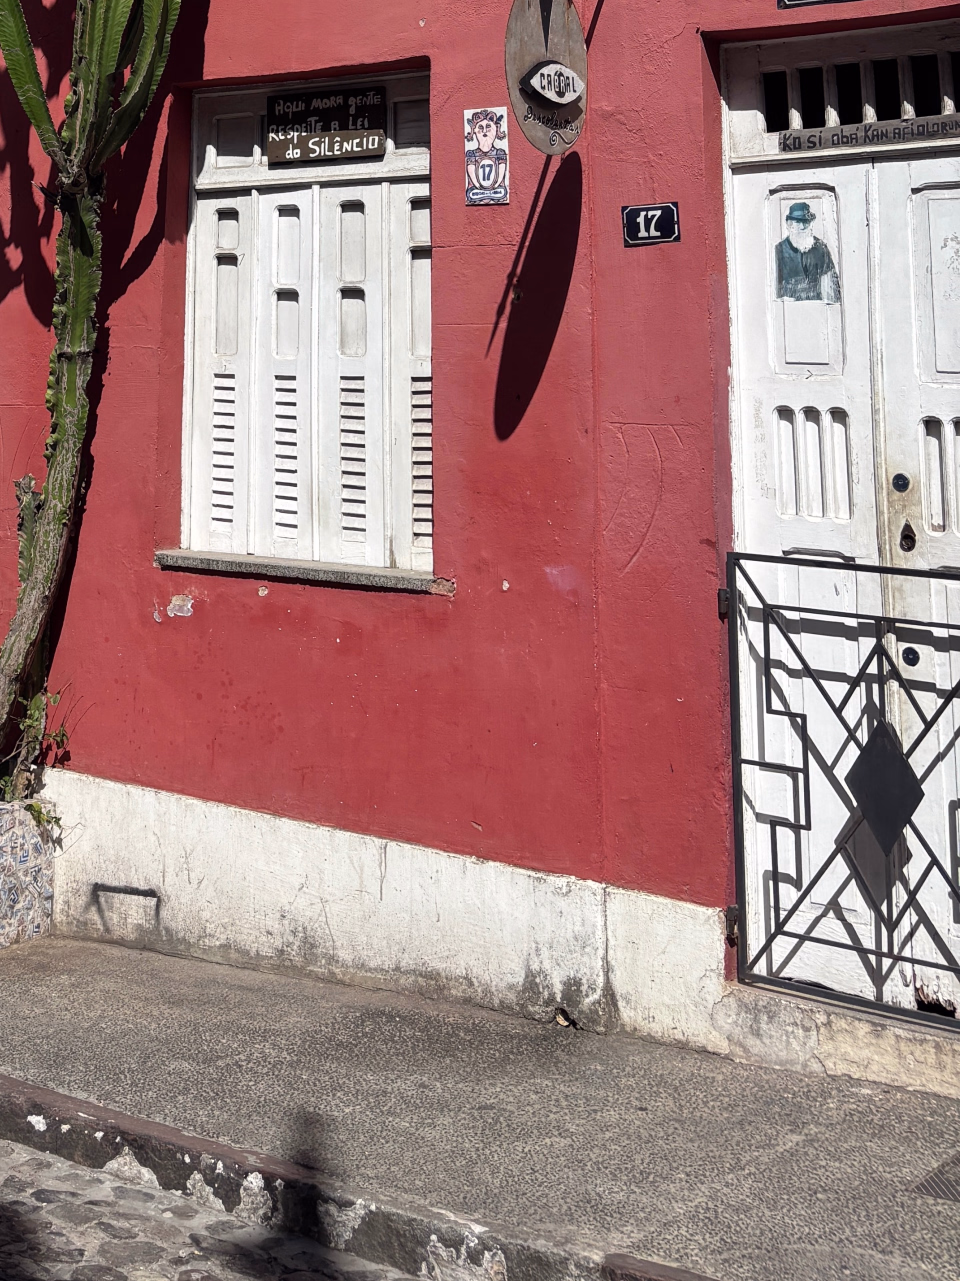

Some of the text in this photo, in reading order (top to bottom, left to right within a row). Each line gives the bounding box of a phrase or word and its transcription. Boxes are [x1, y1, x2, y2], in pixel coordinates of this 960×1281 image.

[540, 71, 577, 95] CABRAL
[310, 95, 343, 110] MORA
[330, 121, 340, 133] A
[782, 133, 802, 152] KO
[863, 124, 889, 144] KAN
[285, 144, 301, 159] do
[480, 163, 494, 182] 17
[636, 209, 662, 238] 17
